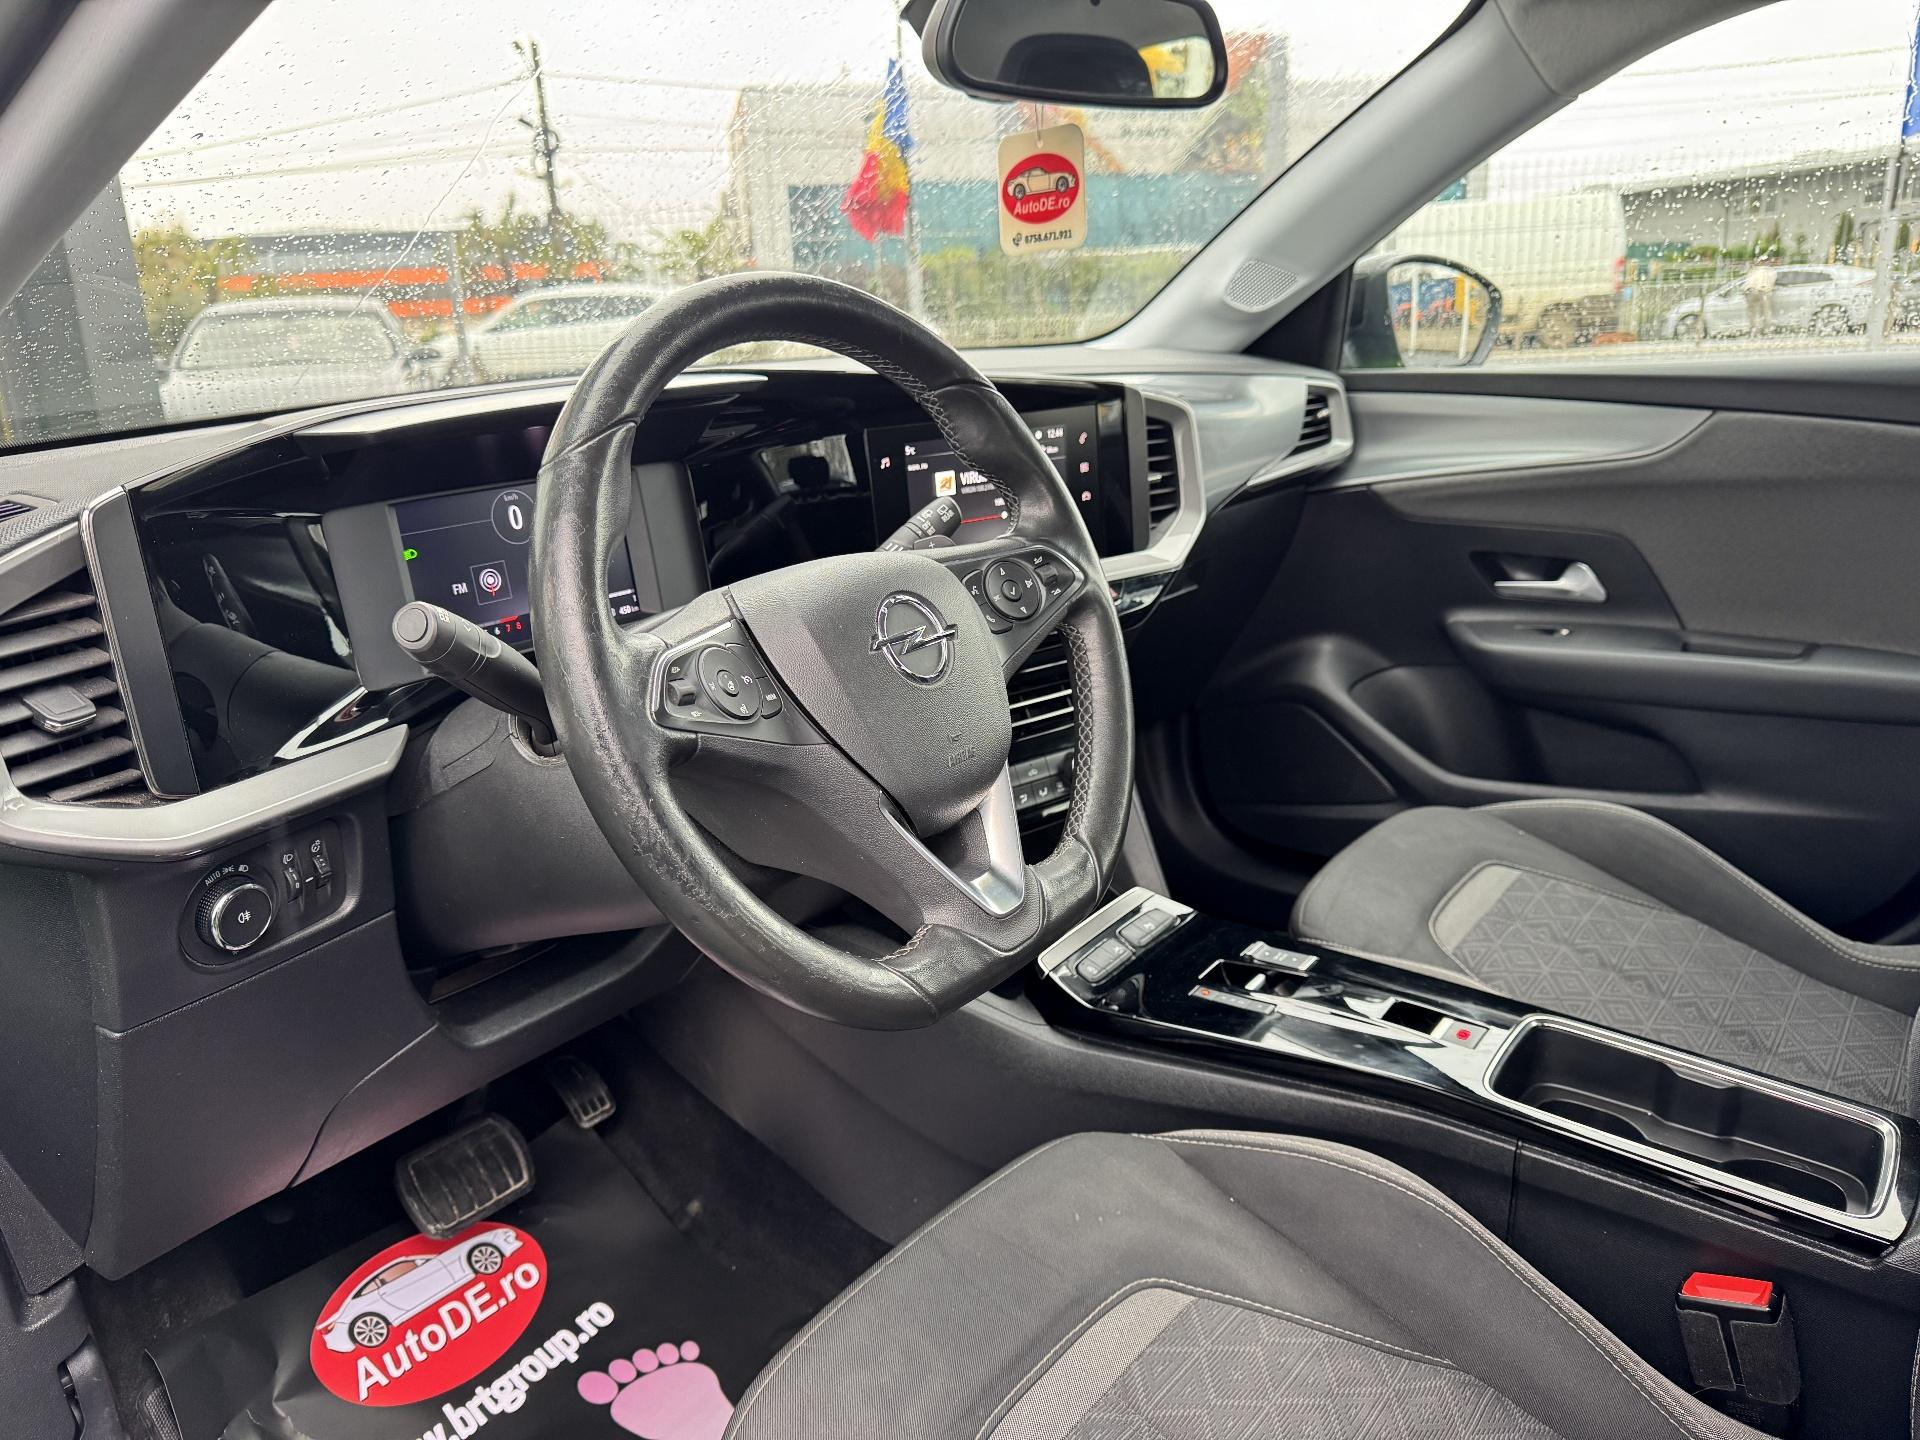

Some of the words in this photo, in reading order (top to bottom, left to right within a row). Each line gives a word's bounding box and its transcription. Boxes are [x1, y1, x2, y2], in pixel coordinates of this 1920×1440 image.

[1013, 196, 1071, 216] AutoDE.ro
[507, 504, 523, 530] 0
[451, 582, 469, 596] FM
[204, 870, 221, 886] AUTO
[357, 1262, 541, 1402] AutoDE.ro
